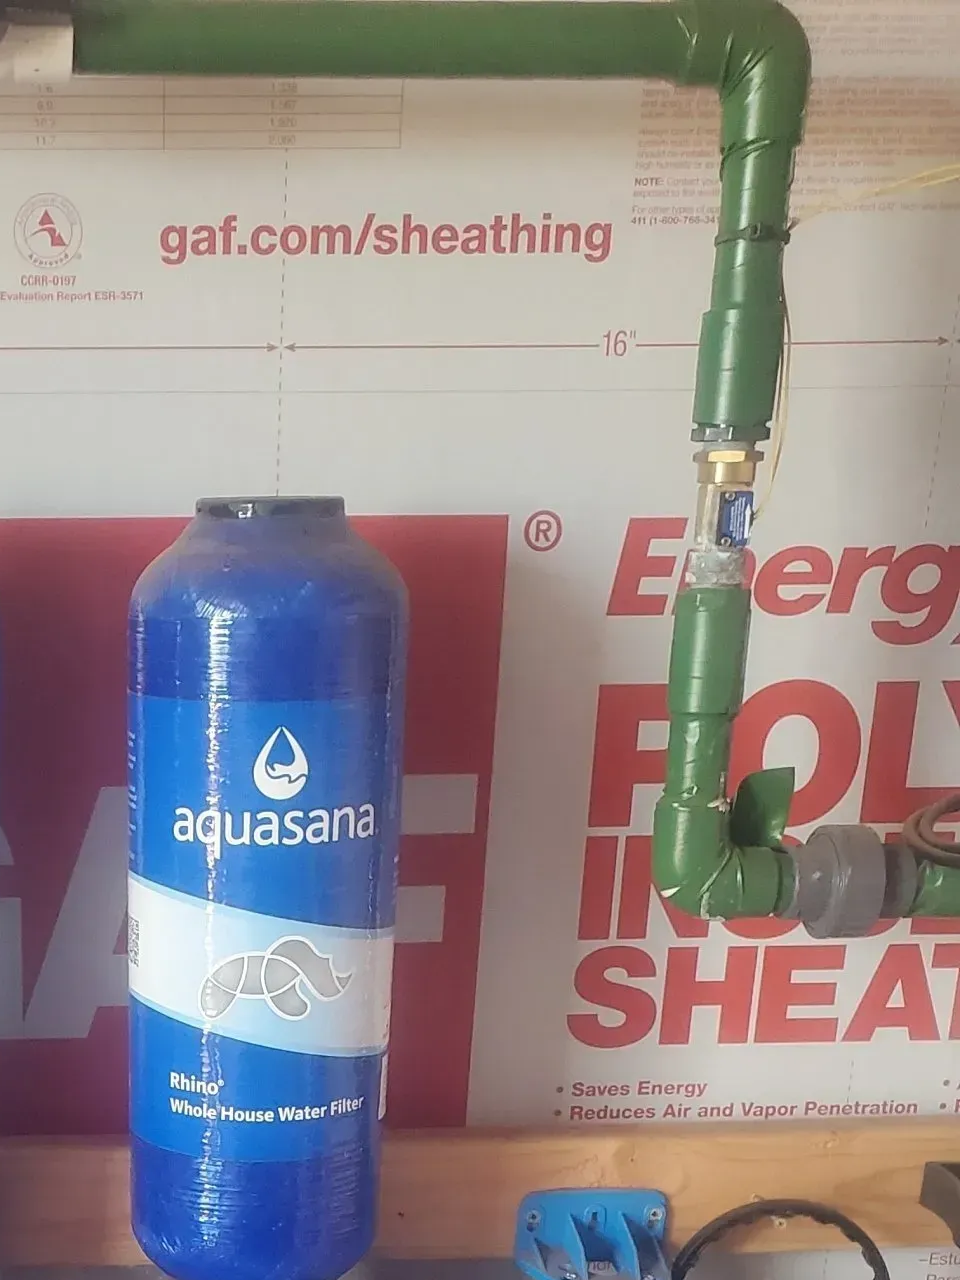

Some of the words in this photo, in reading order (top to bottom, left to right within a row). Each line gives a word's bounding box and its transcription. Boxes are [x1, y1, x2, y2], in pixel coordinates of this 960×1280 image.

[160, 211, 613, 265] gaf.com/sheathing
[0, 291, 55, 302] Evaluation
[56, 291, 91, 303] Report
[94, 291, 144, 301] ESR-3571
[601, 330, 637, 357] 16"
[173, 803, 377, 858] aquasana
[571, 1080, 632, 1098] Saves
[637, 1080, 708, 1099] Energy
[169, 1097, 217, 1119] Whole
[220, 1105, 274, 1122] House
[278, 1104, 327, 1122] Water
[330, 1096, 364, 1117] Filter
[570, 1104, 657, 1121] Reduces
[663, 1103, 691, 1119] Air
[698, 1102, 734, 1118] and
[741, 1102, 797, 1120] Vapor
[804, 1099, 918, 1116] Penetration
